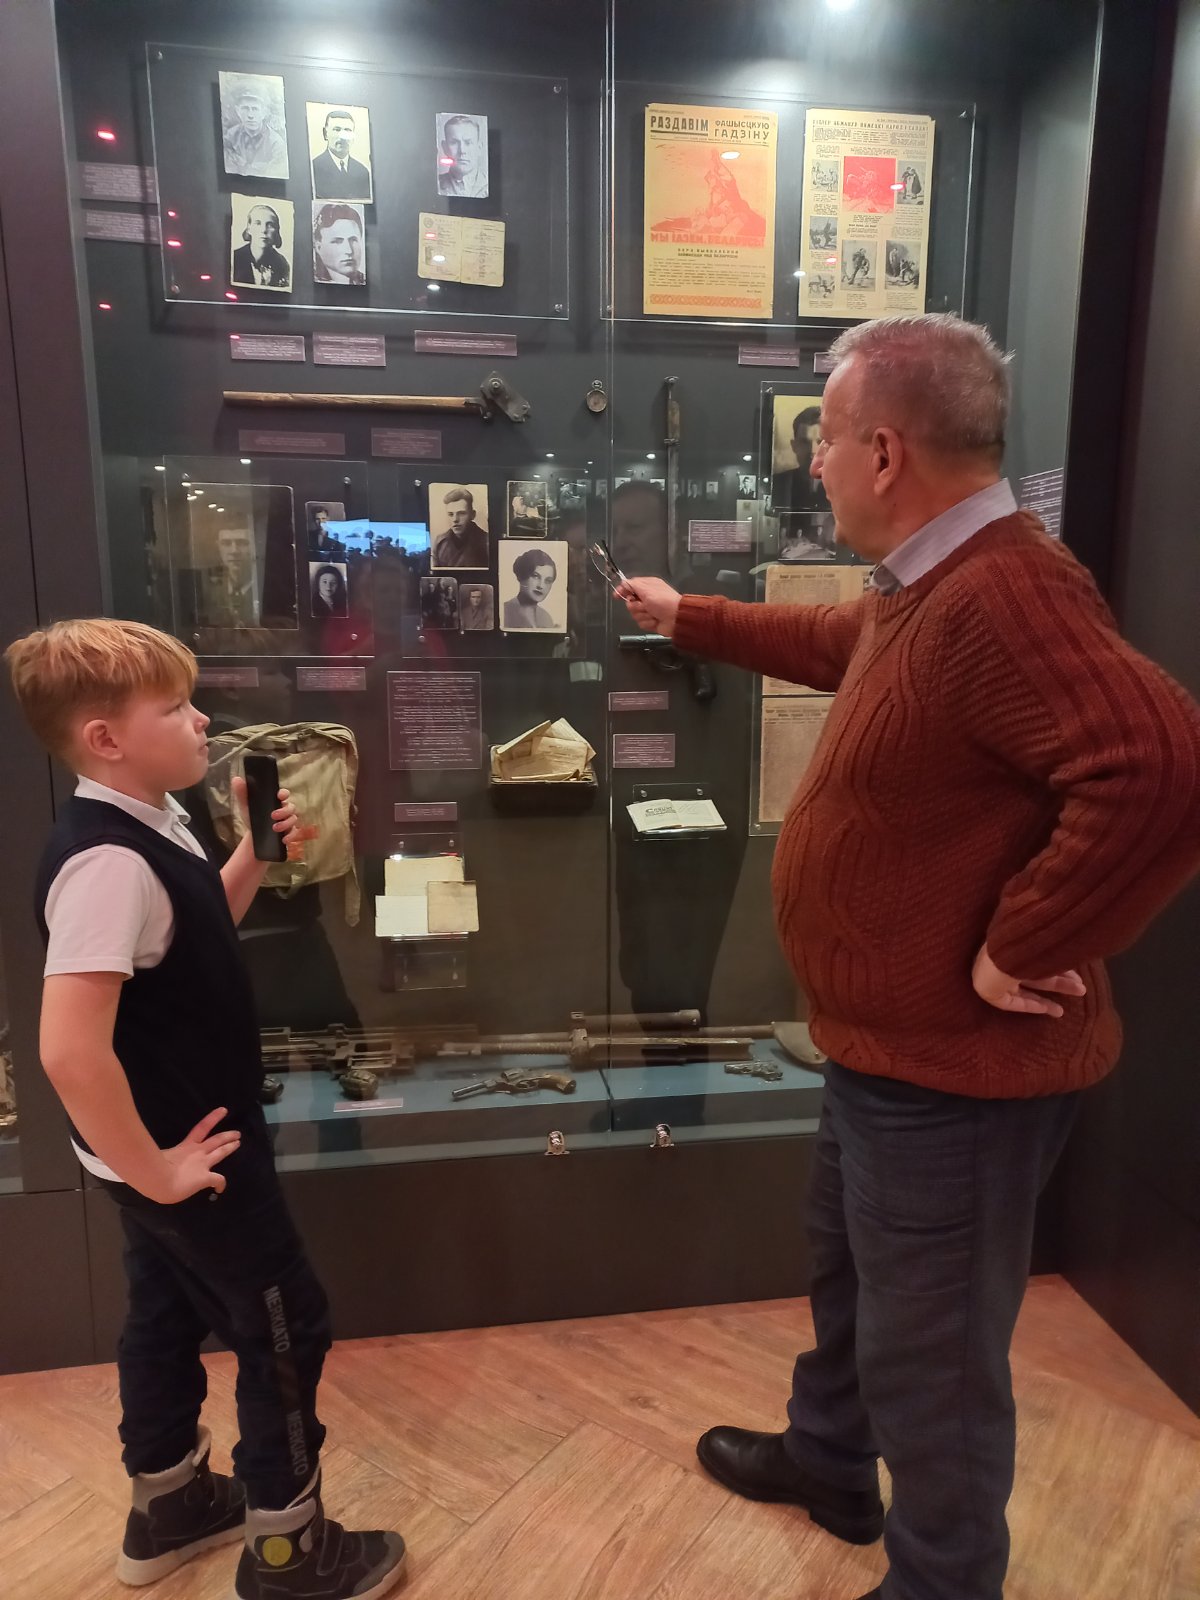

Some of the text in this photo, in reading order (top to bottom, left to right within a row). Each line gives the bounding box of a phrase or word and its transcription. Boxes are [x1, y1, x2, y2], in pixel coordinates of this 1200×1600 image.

[650, 115, 709, 131] РАЗДАВІМ
[714, 120, 770, 130] ФАШЫСЦКУЮ
[714, 128, 770, 140] ГАДЗІНУ
